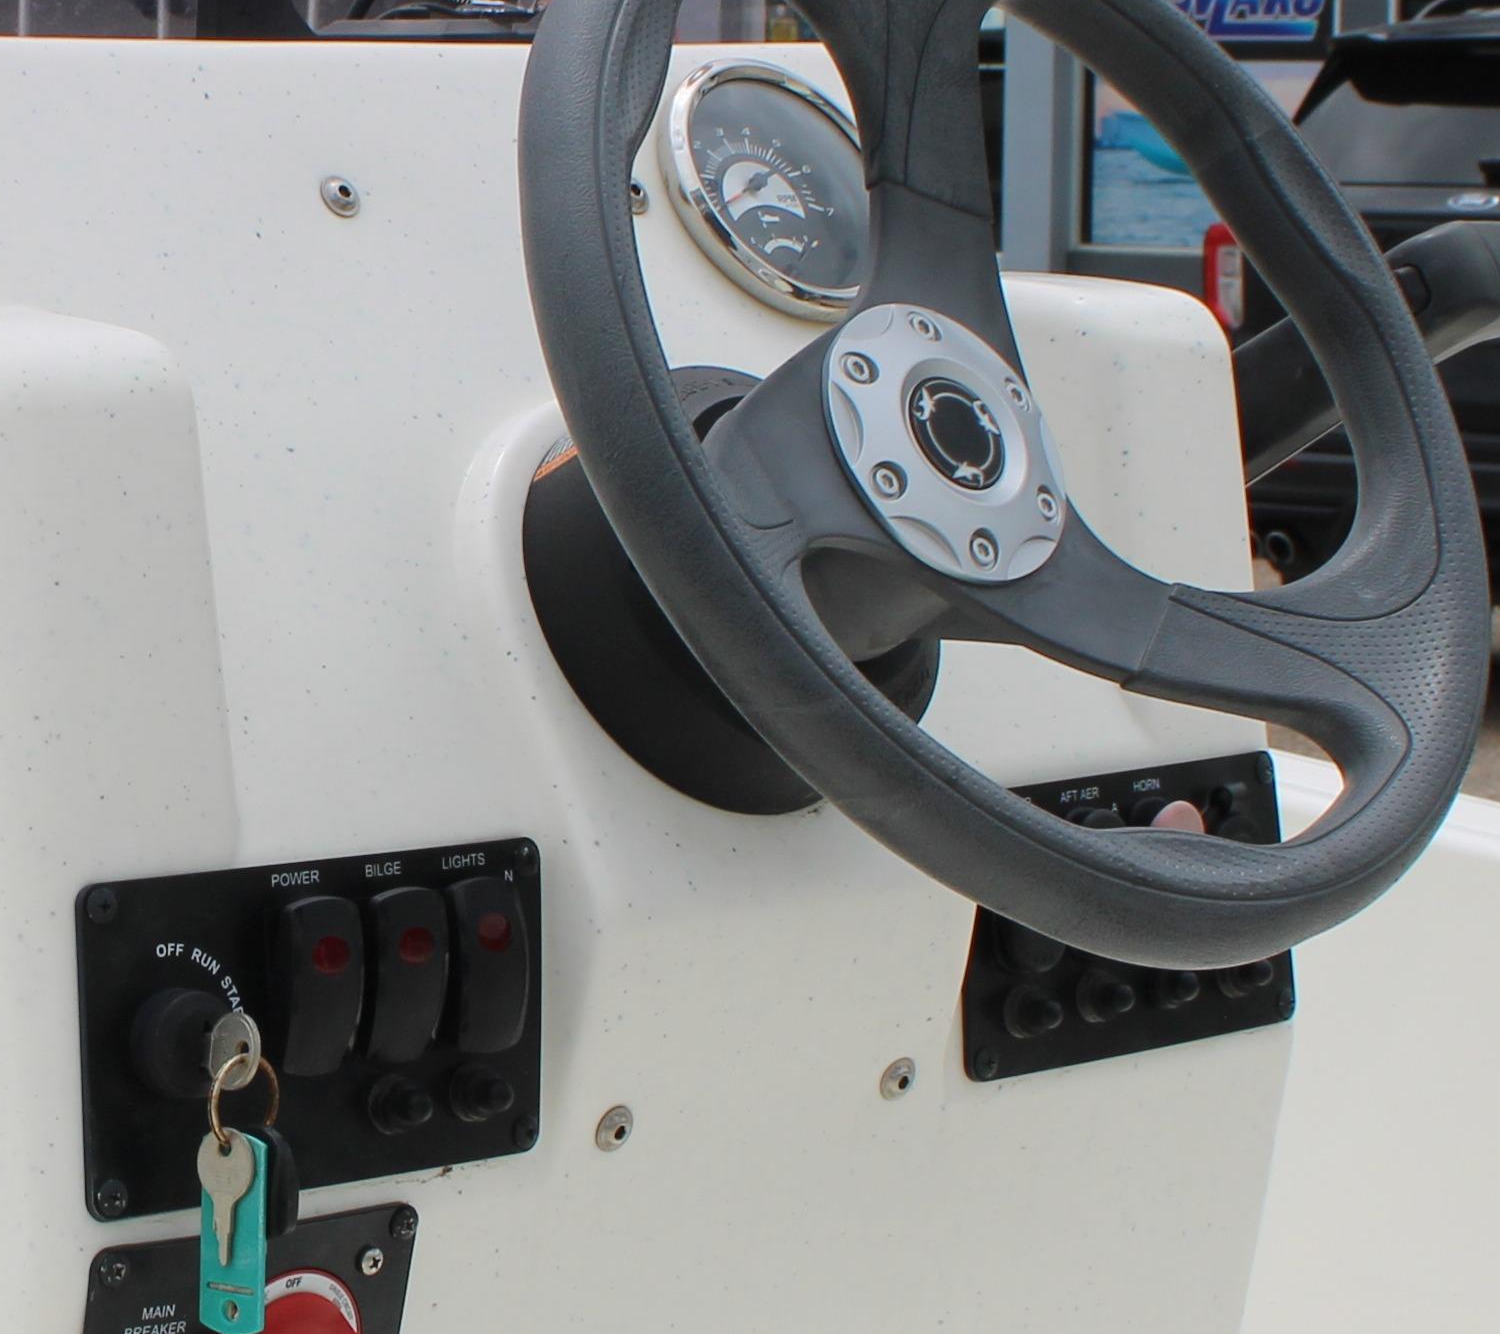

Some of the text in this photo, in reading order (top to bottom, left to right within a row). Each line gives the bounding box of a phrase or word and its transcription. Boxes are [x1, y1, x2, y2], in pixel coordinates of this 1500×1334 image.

[1133, 778, 1161, 792] HORN
[1060, 786, 1099, 803] AFT AER
[365, 861, 402, 878] BILGE
[442, 853, 486, 870] LIGHTS
[271, 870, 320, 887] POWER
[504, 870, 514, 882] N
[156, 943, 245, 1014] OFF RUN STAR
[285, 1277, 303, 1289] OFF
[142, 1303, 176, 1321] MAIN
